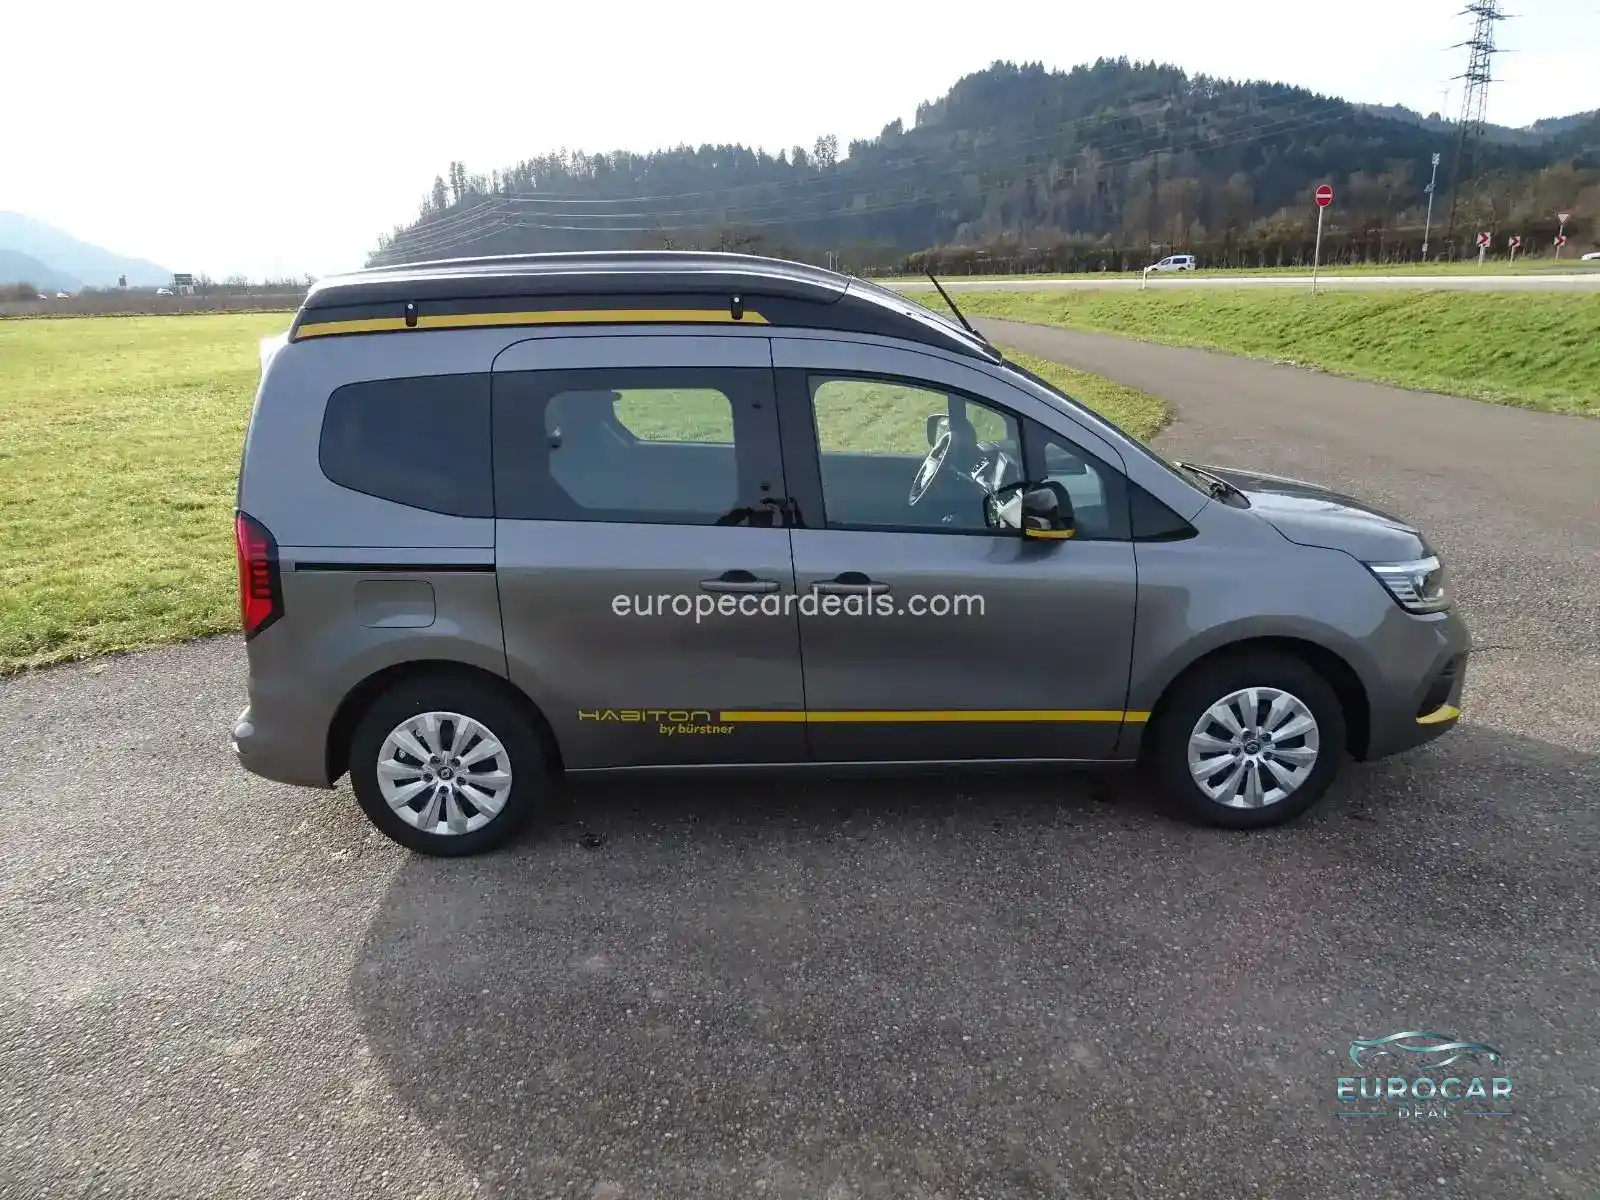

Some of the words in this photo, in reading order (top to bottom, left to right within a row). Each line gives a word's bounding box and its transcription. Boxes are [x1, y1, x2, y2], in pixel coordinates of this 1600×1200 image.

[578, 710, 711, 722] HABITON
[660, 723, 675, 736] by
[678, 723, 735, 735] bürstner
